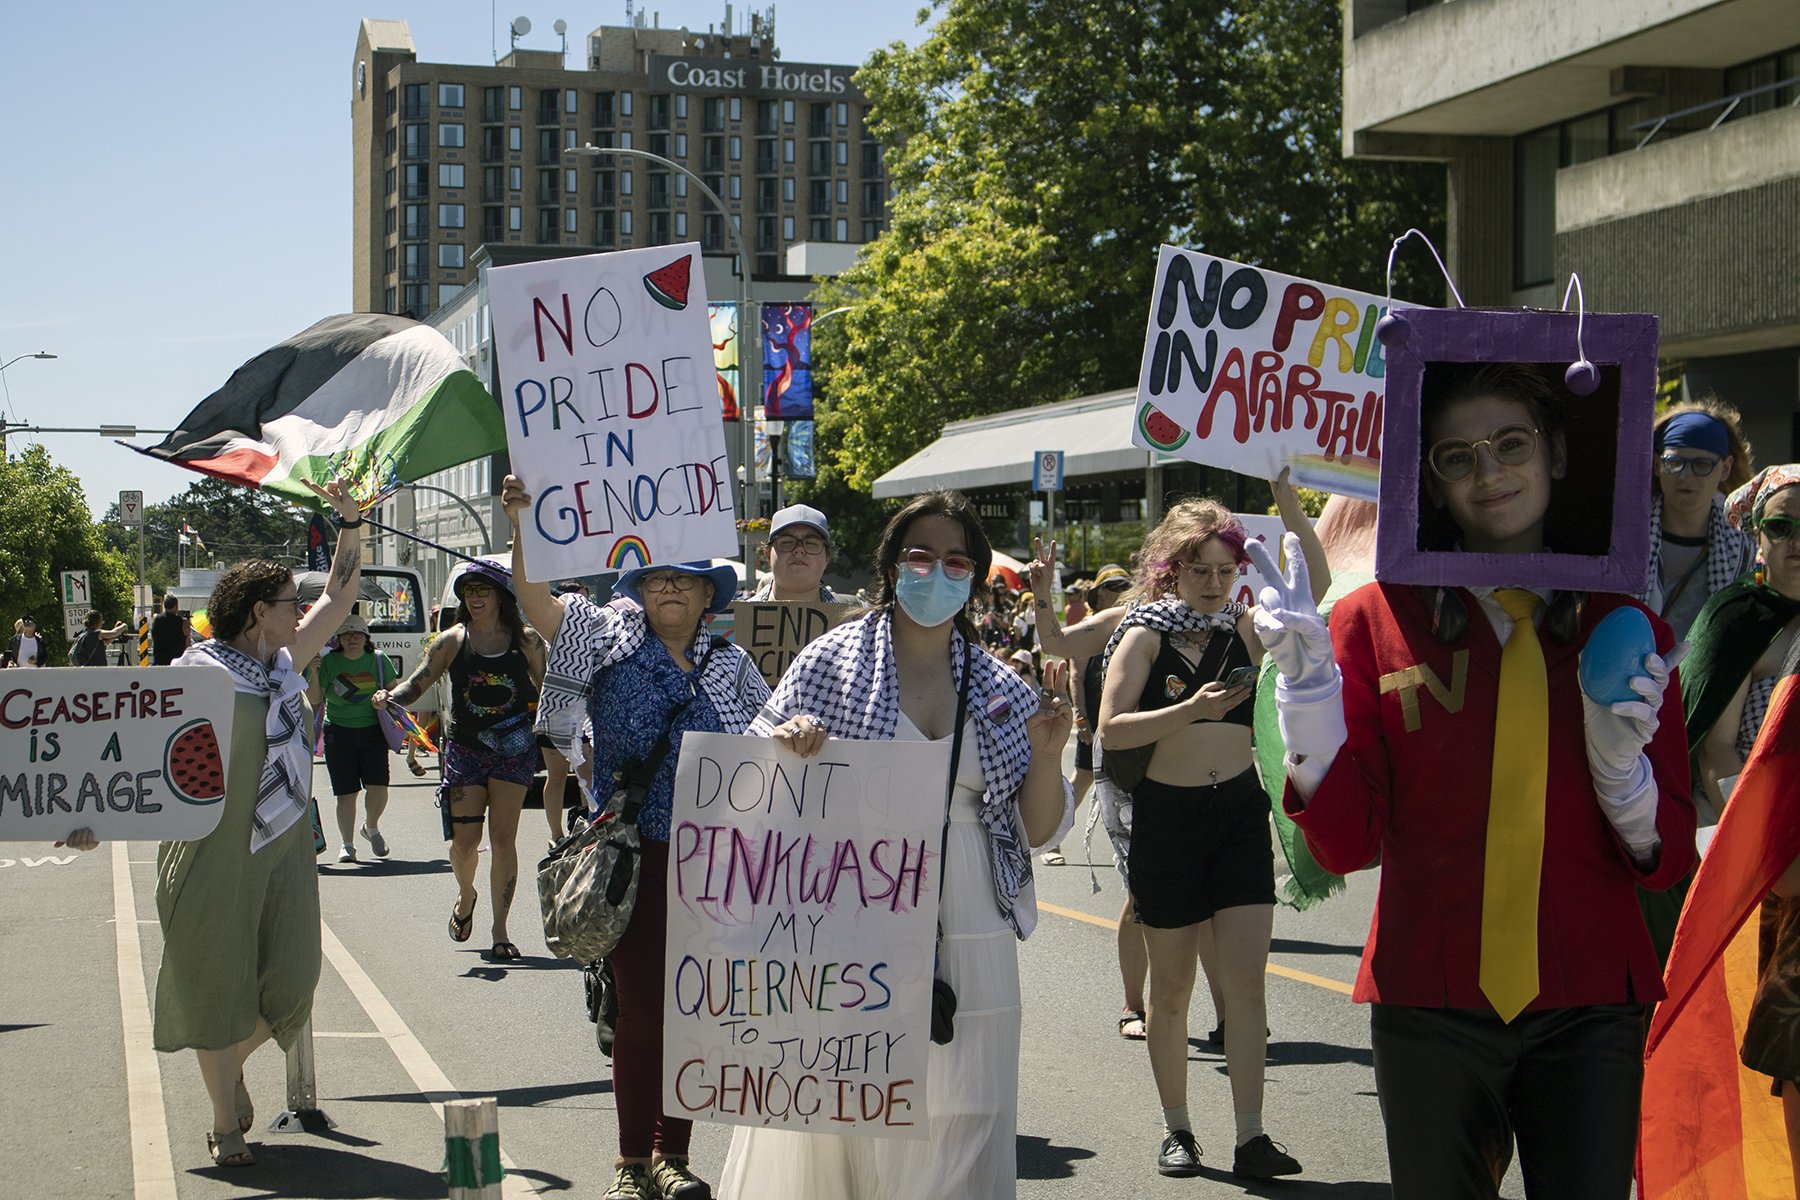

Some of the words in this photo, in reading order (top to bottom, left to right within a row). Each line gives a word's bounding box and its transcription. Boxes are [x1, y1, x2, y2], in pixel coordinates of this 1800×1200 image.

[667, 61, 747, 89] Coast
[759, 65, 846, 94] Hotels
[1157, 253, 1268, 330] NO
[533, 286, 621, 362] NO
[1149, 329, 1218, 396] IN
[514, 356, 703, 437] PRIDE
[575, 429, 634, 467] IN
[535, 455, 733, 545] GENOCIDE
[980, 504, 1008, 517] GRILL
[68, 608, 89, 618] STOP
[69, 618, 83, 626] LIN
[751, 605, 829, 647] END
[1, 681, 184, 729] CEASEFIRE
[1379, 649, 1469, 732] TV
[100, 731, 122, 762] A
[0, 769, 163, 818] MIRAGE
[696, 757, 849, 819] DONT
[676, 820, 930, 913] PINKWASH
[760, 911, 824, 955] MY
[676, 955, 892, 1020] QUEERNESS
[768, 1032, 906, 1077] JUSTIFY
[676, 1058, 914, 1126] GENOCIDE
